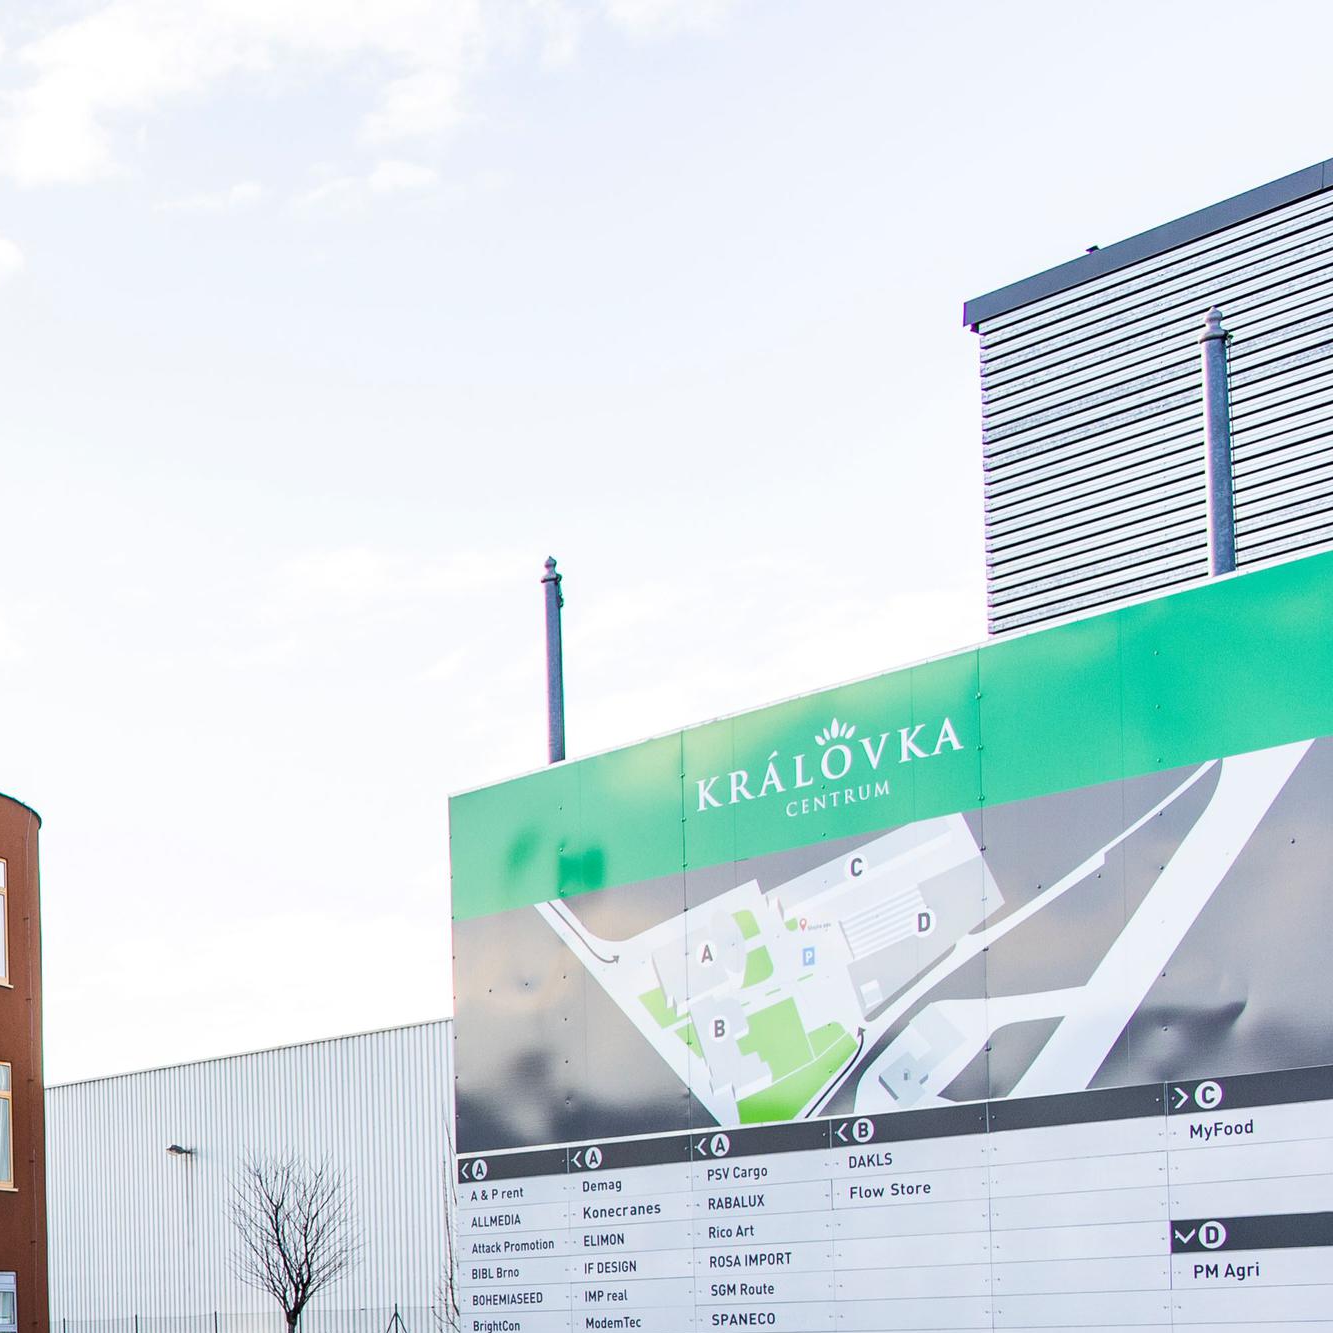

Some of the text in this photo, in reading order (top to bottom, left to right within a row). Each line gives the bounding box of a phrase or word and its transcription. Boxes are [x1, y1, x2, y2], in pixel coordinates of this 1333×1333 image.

[695, 716, 965, 812] KRÁLOVKA
[785, 779, 891, 817] CENTRUM
[849, 858, 863, 876] C
[917, 912, 932, 933] D
[701, 945, 714, 963] A
[713, 1019, 726, 1037] B
[1201, 1085, 1215, 1104] C
[858, 1122, 869, 1138] B
[1190, 1120, 1254, 1140] MyFood
[715, 1138, 726, 1153] A
[588, 1151, 599, 1165] A
[849, 1153, 893, 1168] DAKLS
[475, 1163, 485, 1176] A
[707, 1165, 768, 1181] PSV Cargo
[582, 1179, 622, 1193] Demag
[850, 1182, 931, 1199] Flow Store
[471, 1187, 524, 1201] A & P rent
[708, 1195, 765, 1210] RABALUX
[583, 1202, 661, 1219] Konecranes
[471, 1214, 521, 1227] ALLMEDIA
[708, 1225, 755, 1238] Rico Art
[1205, 1226, 1219, 1244] D
[472, 1239, 554, 1254] Attack Promotion
[583, 1233, 624, 1247] ELIMON
[584, 1261, 637, 1274] IF DESIGN
[709, 1252, 792, 1268] ROSA IMPORT
[471, 1268, 519, 1279] BIBL Brno
[1194, 1262, 1260, 1280] PM Agri
[584, 1289, 628, 1302] IMP real
[711, 1283, 775, 1296] SGM Route
[472, 1292, 543, 1306] BOHEMIASEED
[473, 1321, 521, 1333] BrightCon
[586, 1317, 642, 1329] ModemTec
[711, 1313, 776, 1326] SPANECO
